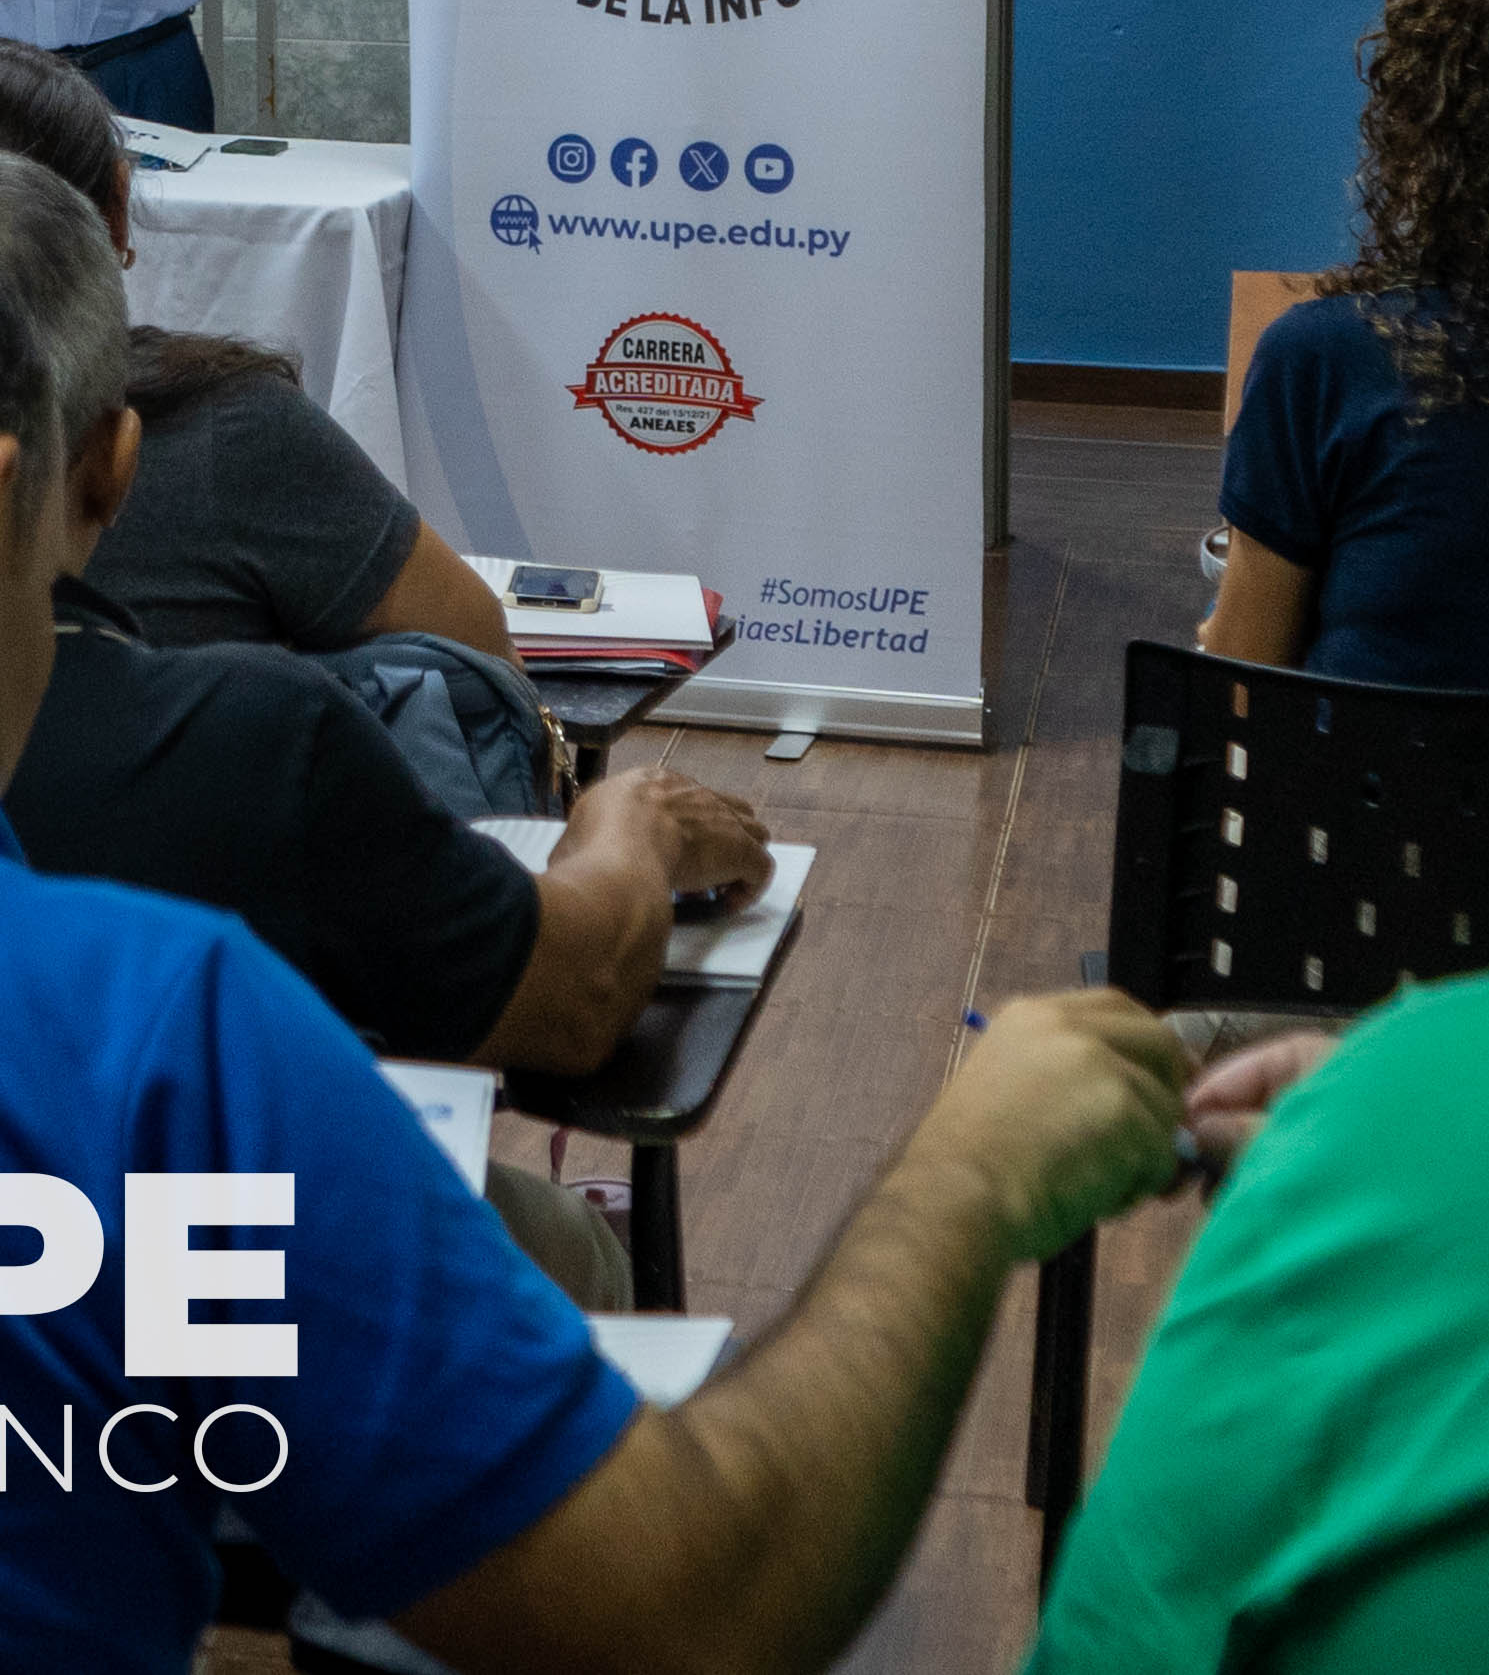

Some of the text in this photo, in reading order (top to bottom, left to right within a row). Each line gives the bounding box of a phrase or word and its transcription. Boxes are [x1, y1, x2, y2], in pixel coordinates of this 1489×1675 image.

[547, 213, 851, 258] www.upe.edu.py
[622, 337, 706, 365] CARRERA
[594, 371, 735, 404] ACREDITADA
[629, 416, 697, 435] ANEAES
[760, 576, 929, 617] #SomosUPE
[736, 614, 929, 654] iaesLibertad
